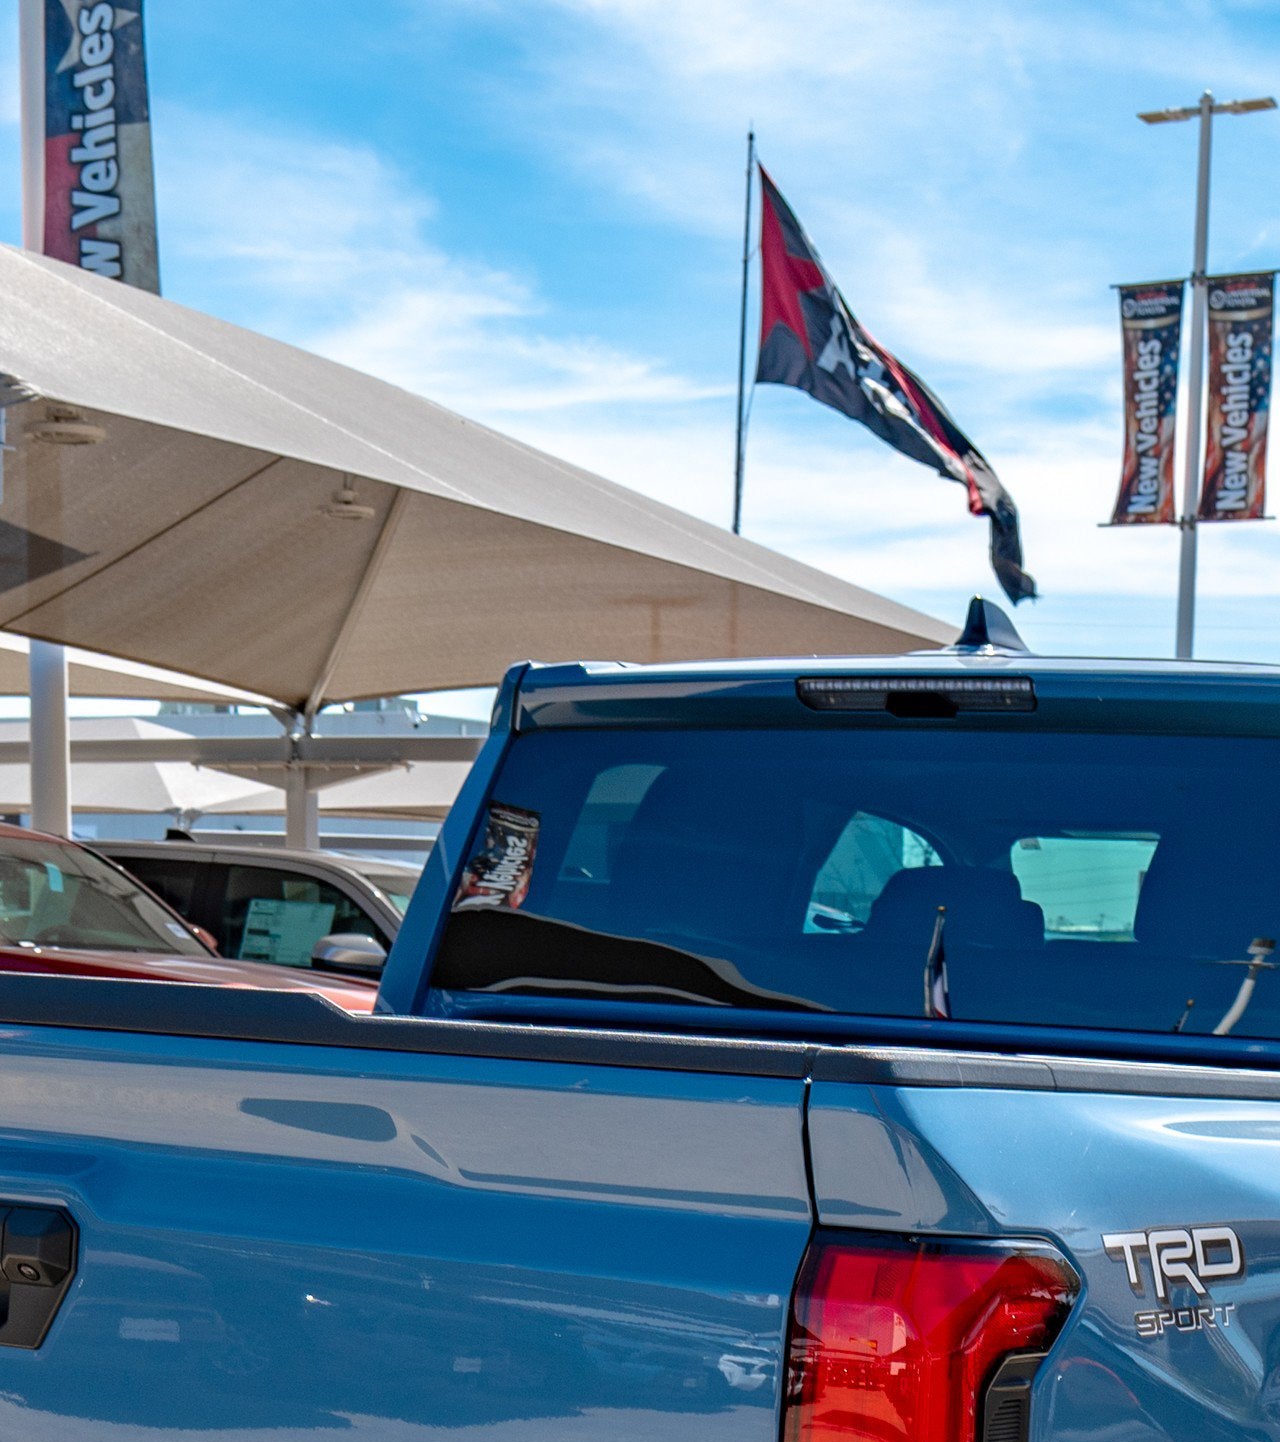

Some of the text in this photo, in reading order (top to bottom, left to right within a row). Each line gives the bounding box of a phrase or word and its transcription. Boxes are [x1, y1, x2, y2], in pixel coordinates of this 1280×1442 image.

[71, 2, 121, 231] Vehicles
[1133, 338, 1162, 453] Vehicles
[1221, 332, 1253, 447] Vehicles
[1126, 452, 1159, 514] New
[1216, 450, 1248, 511] New
[1101, 1226, 1243, 1299] TRD
[1134, 1303, 1235, 1337] SPORT
